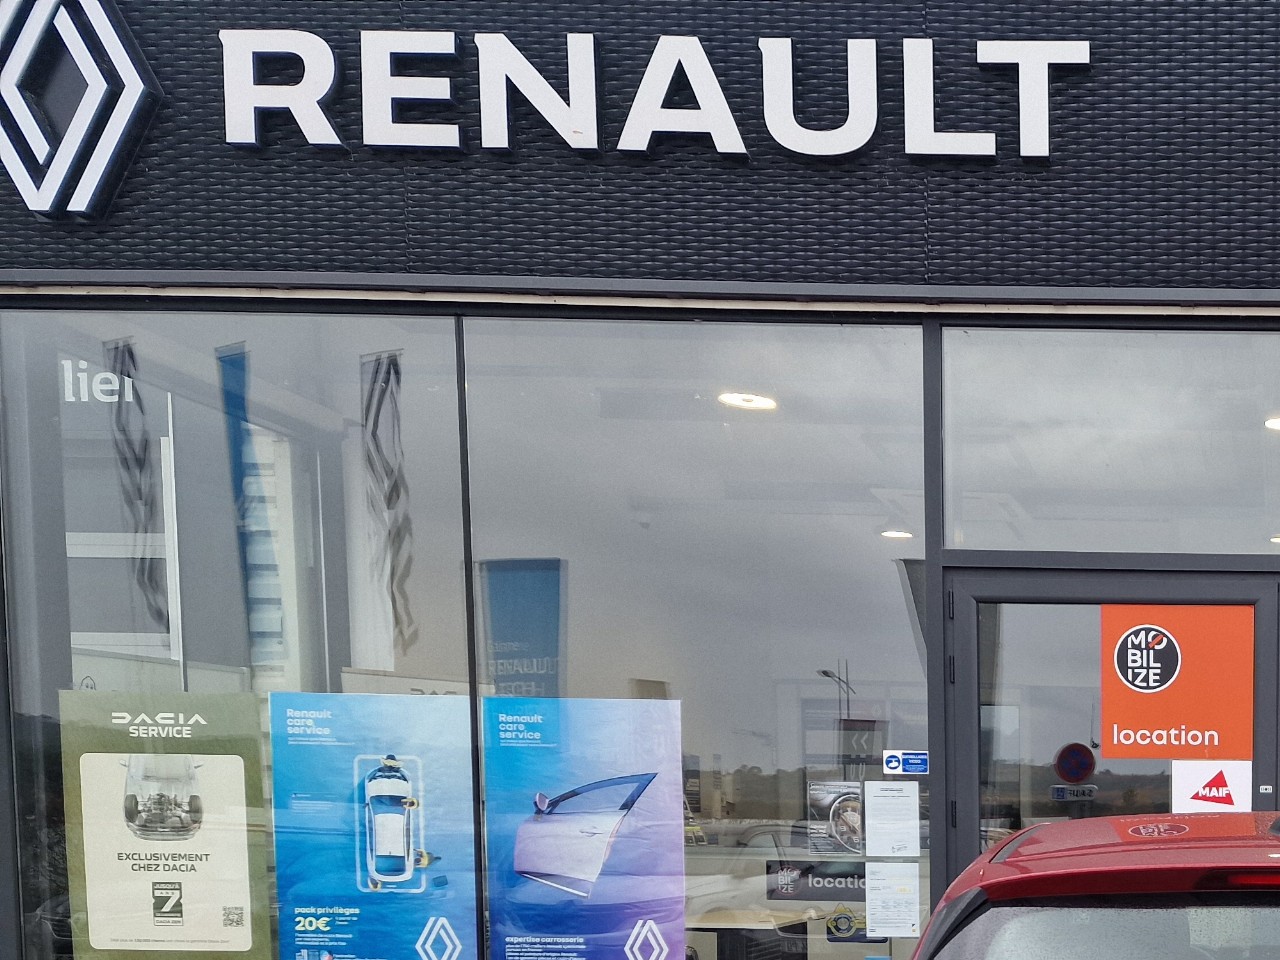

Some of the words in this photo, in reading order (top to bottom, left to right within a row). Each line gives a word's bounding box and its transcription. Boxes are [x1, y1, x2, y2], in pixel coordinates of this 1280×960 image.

[218, 29, 1091, 158] RENAULT
[112, 712, 208, 724] DACIA
[286, 709, 332, 718] Renault
[498, 714, 543, 723] Renault
[129, 725, 192, 738] SERVICE
[287, 726, 330, 734] service
[499, 730, 541, 739] service
[1113, 723, 1219, 746] location
[1199, 787, 1231, 798] MAIF
[117, 852, 211, 862] EXCLUSIVEMENT
[131, 863, 160, 872] CHEZ
[163, 864, 197, 872] DACIA
[808, 874, 866, 888] locatio
[154, 889, 181, 912] 7
[294, 906, 316, 914] pack
[317, 906, 360, 915] privilèges
[505, 936, 540, 944] expertise
